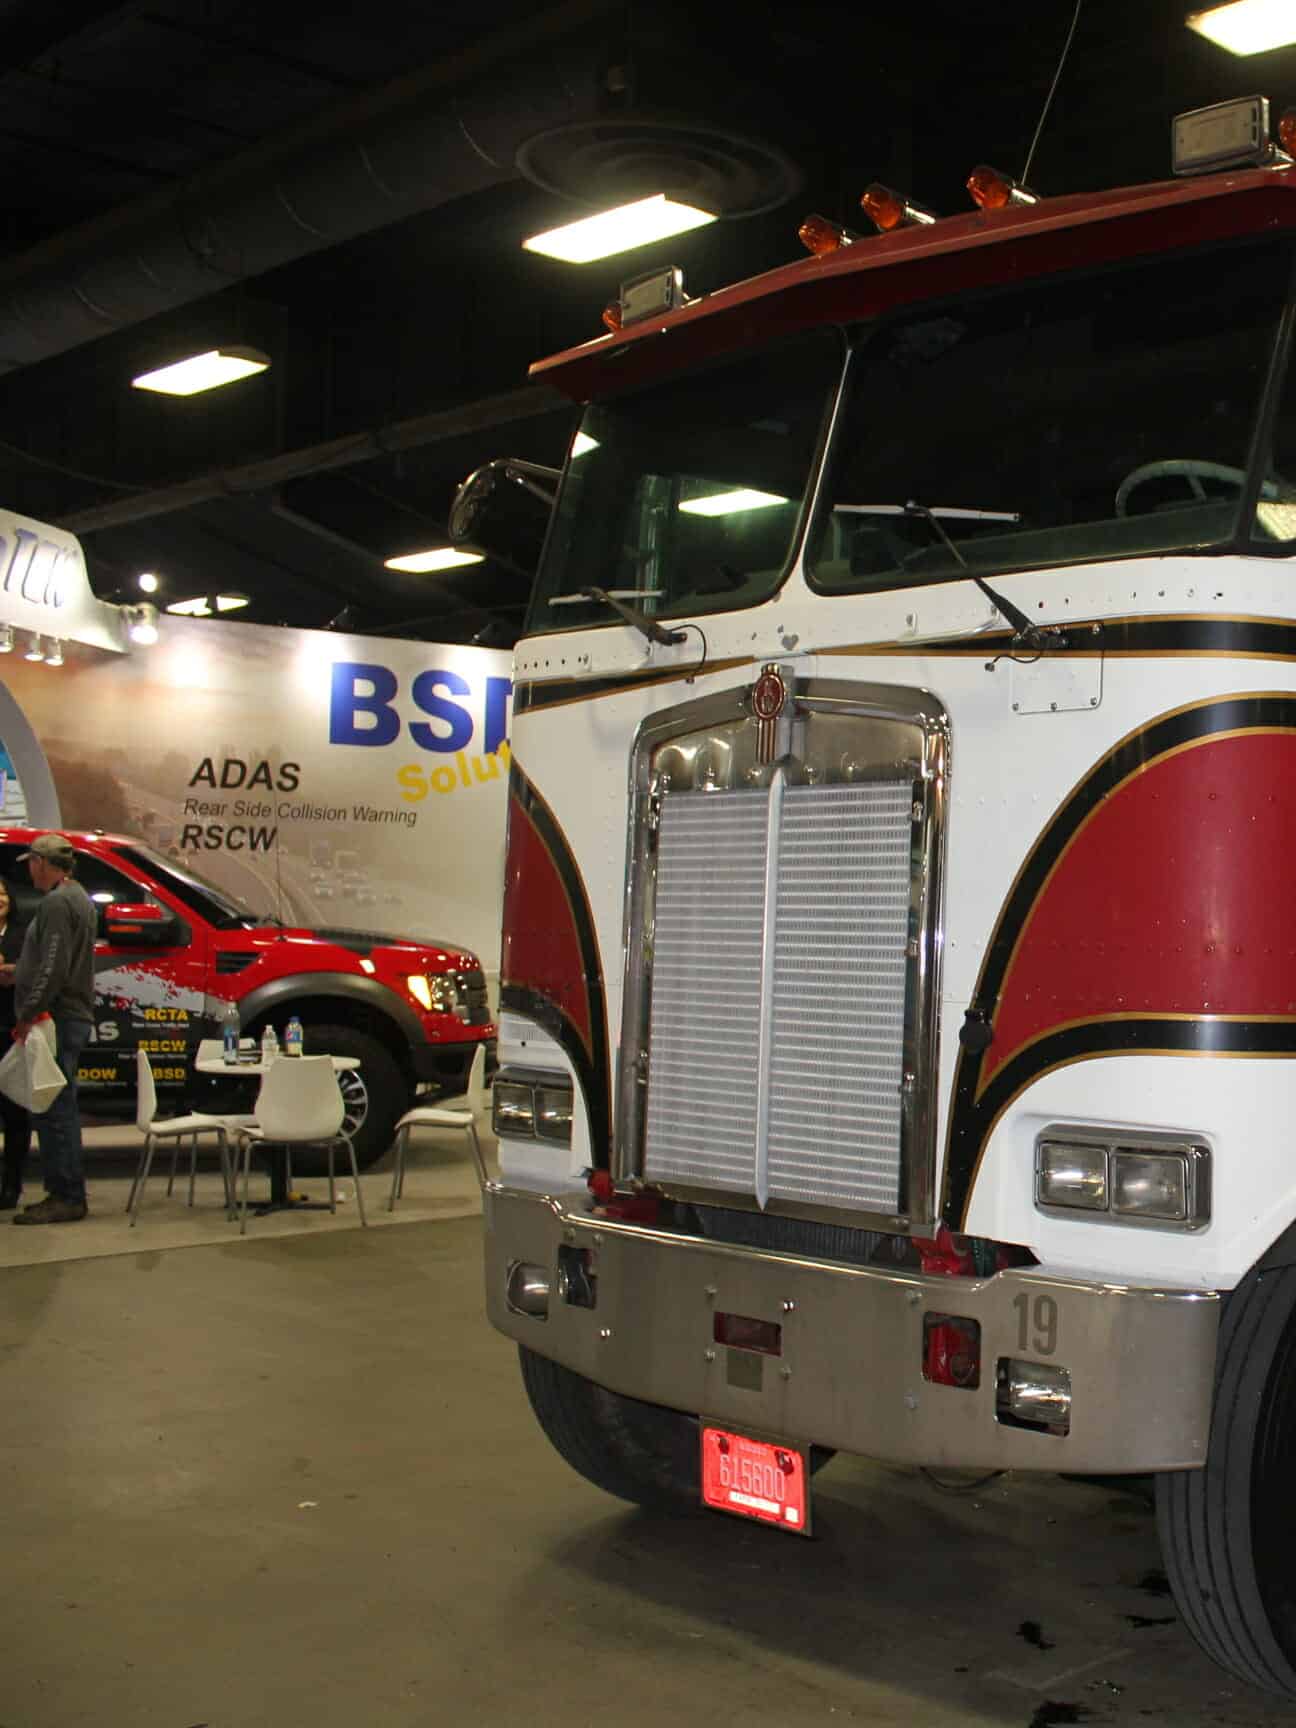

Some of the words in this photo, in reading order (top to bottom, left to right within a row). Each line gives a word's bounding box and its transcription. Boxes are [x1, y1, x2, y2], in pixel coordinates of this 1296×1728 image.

[187, 757, 301, 792] ADAS
[183, 798, 228, 817] Rear
[232, 800, 272, 818] Side
[277, 802, 347, 822] Collision
[352, 805, 418, 828] Warning
[180, 823, 278, 853] RSCW
[144, 1009, 188, 1020] RCTA
[1013, 1293, 1057, 1355] 19
